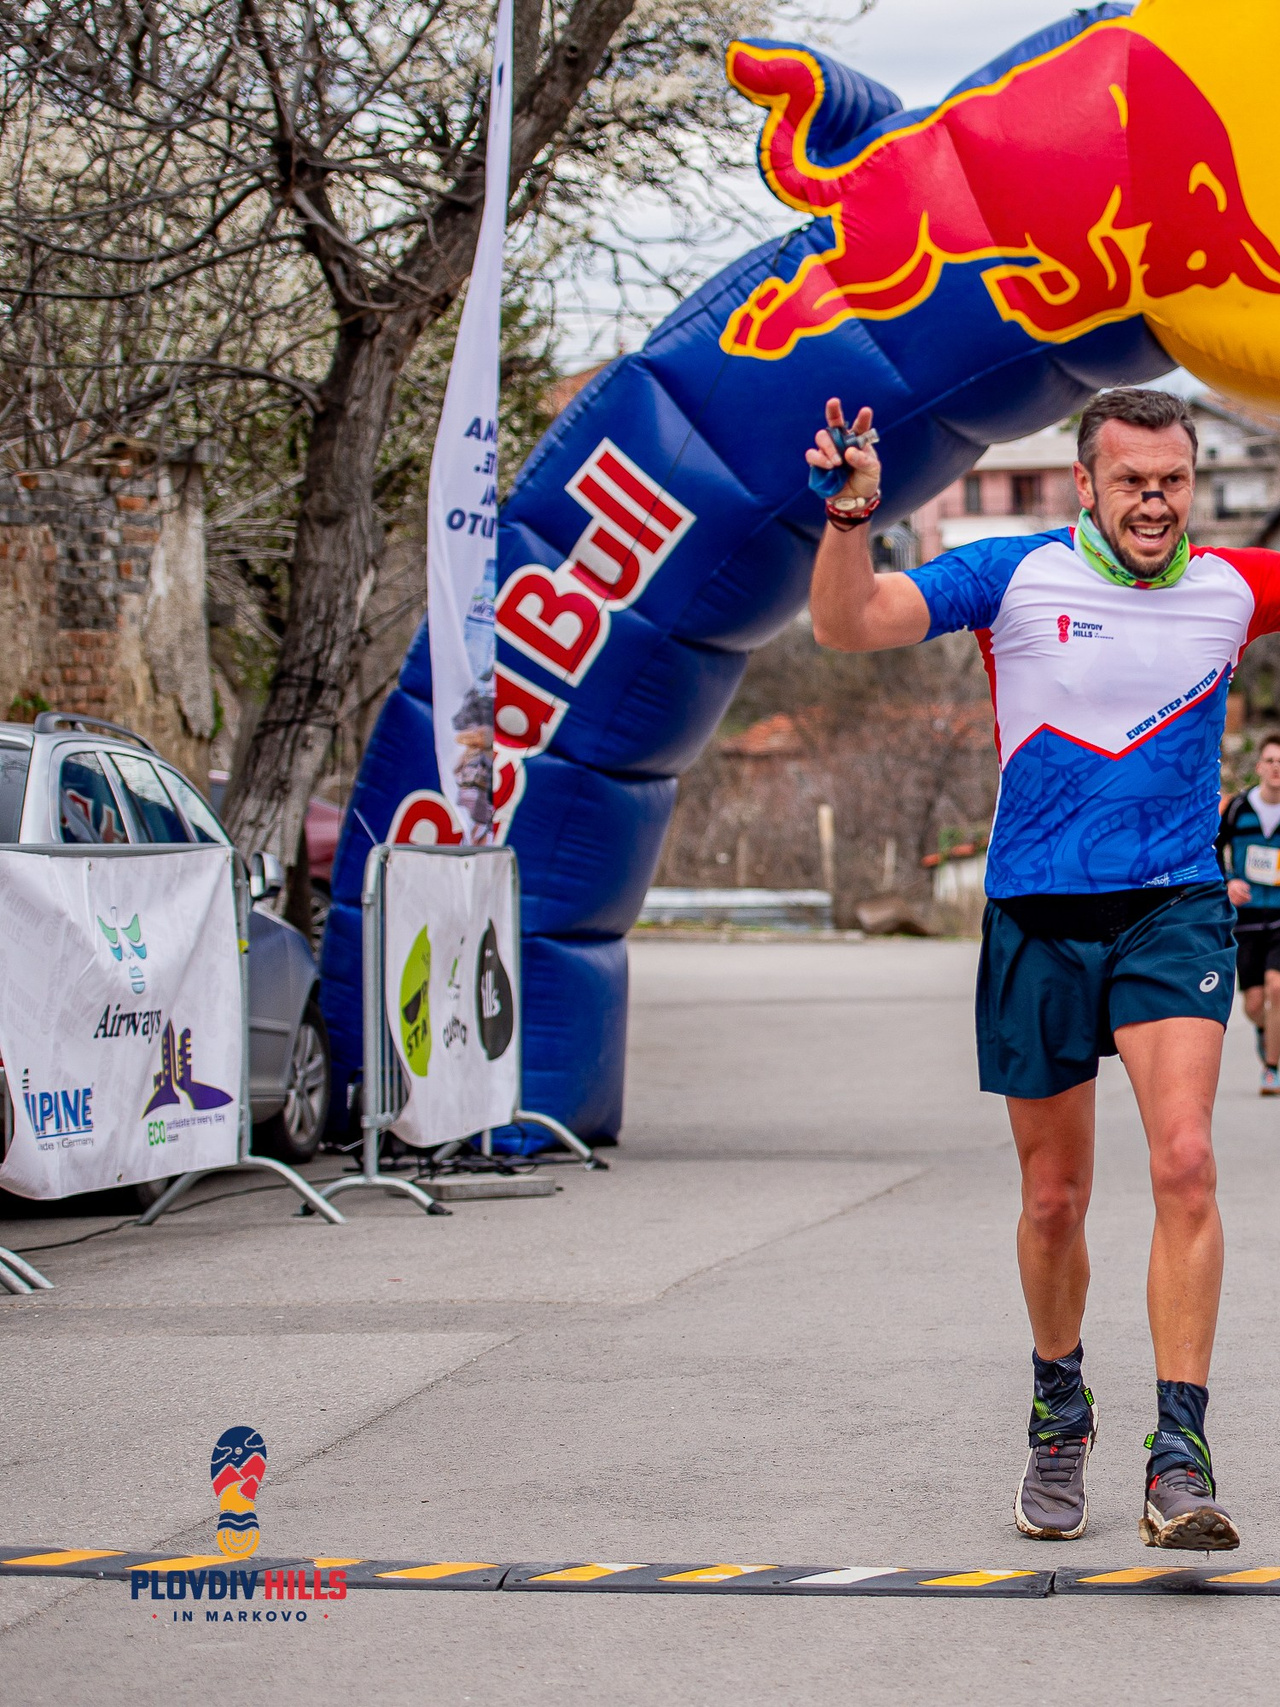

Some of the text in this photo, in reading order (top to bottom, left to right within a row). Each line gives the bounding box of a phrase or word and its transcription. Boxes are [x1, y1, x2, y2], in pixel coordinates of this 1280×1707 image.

[496, 450, 684, 674] Bull
[1072, 630, 1093, 638] HILLS
[1126, 667, 1218, 740] EVERY STEP MATTERS
[93, 1003, 162, 1044] Airways
[148, 1120, 166, 1146] ECO
